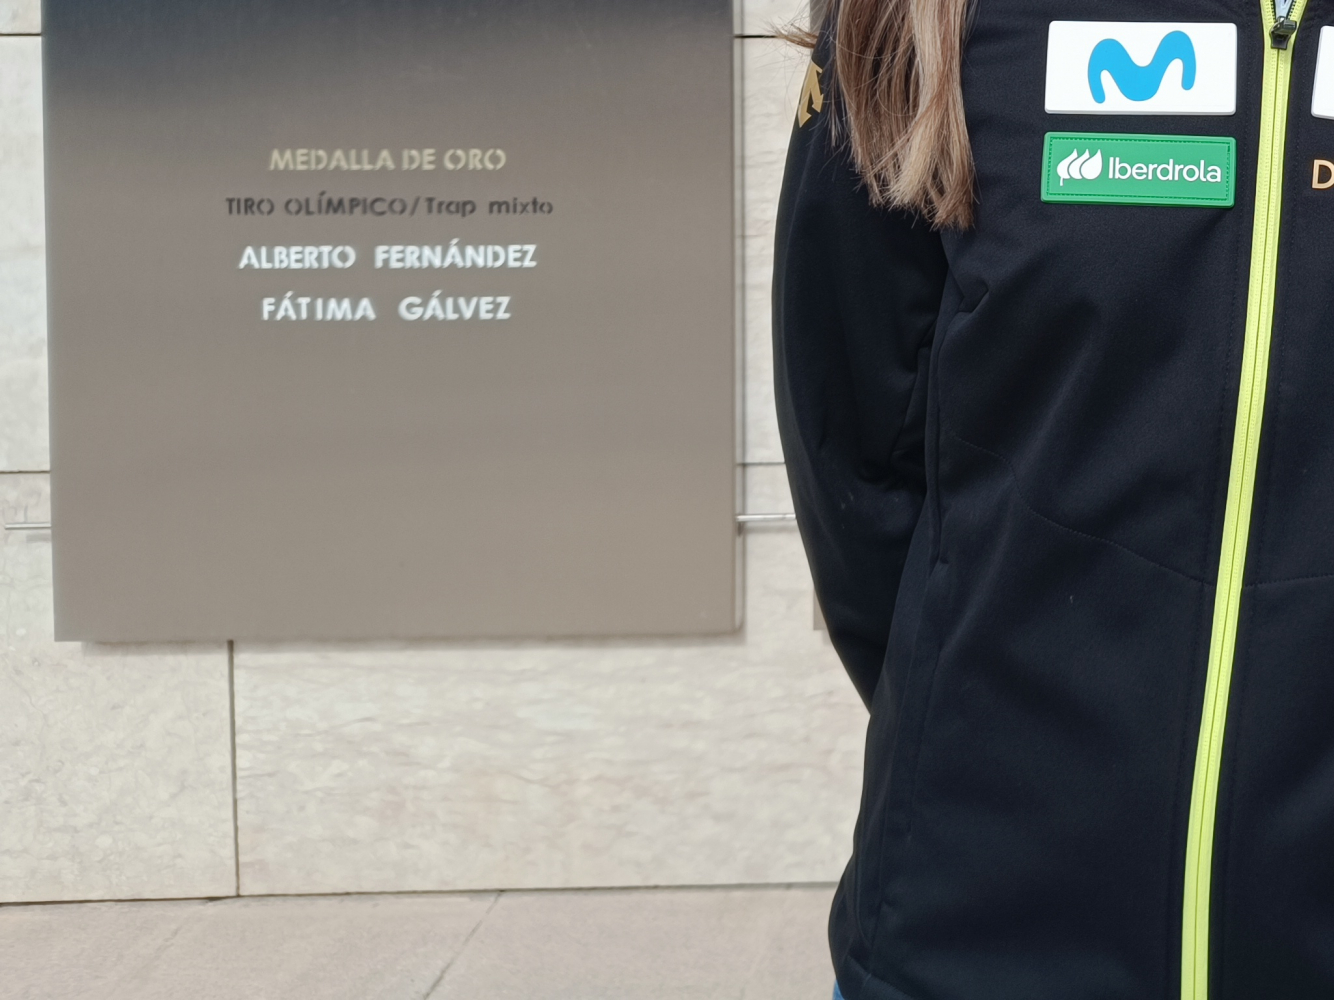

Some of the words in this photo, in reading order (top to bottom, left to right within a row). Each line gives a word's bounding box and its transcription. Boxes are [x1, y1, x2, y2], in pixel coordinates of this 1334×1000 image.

[269, 149, 395, 170] MEDALLA
[402, 148, 435, 170] DE
[444, 149, 506, 170] ORO
[1108, 156, 1221, 183] Iberdrola
[226, 198, 274, 216] TIRO
[489, 198, 553, 215] mixto
[239, 245, 356, 269] ALBERTO
[375, 238, 537, 268] FERNÁNDEZ
[262, 291, 376, 320] FÁTIMA
[399, 290, 510, 320] GÁLVEZ
